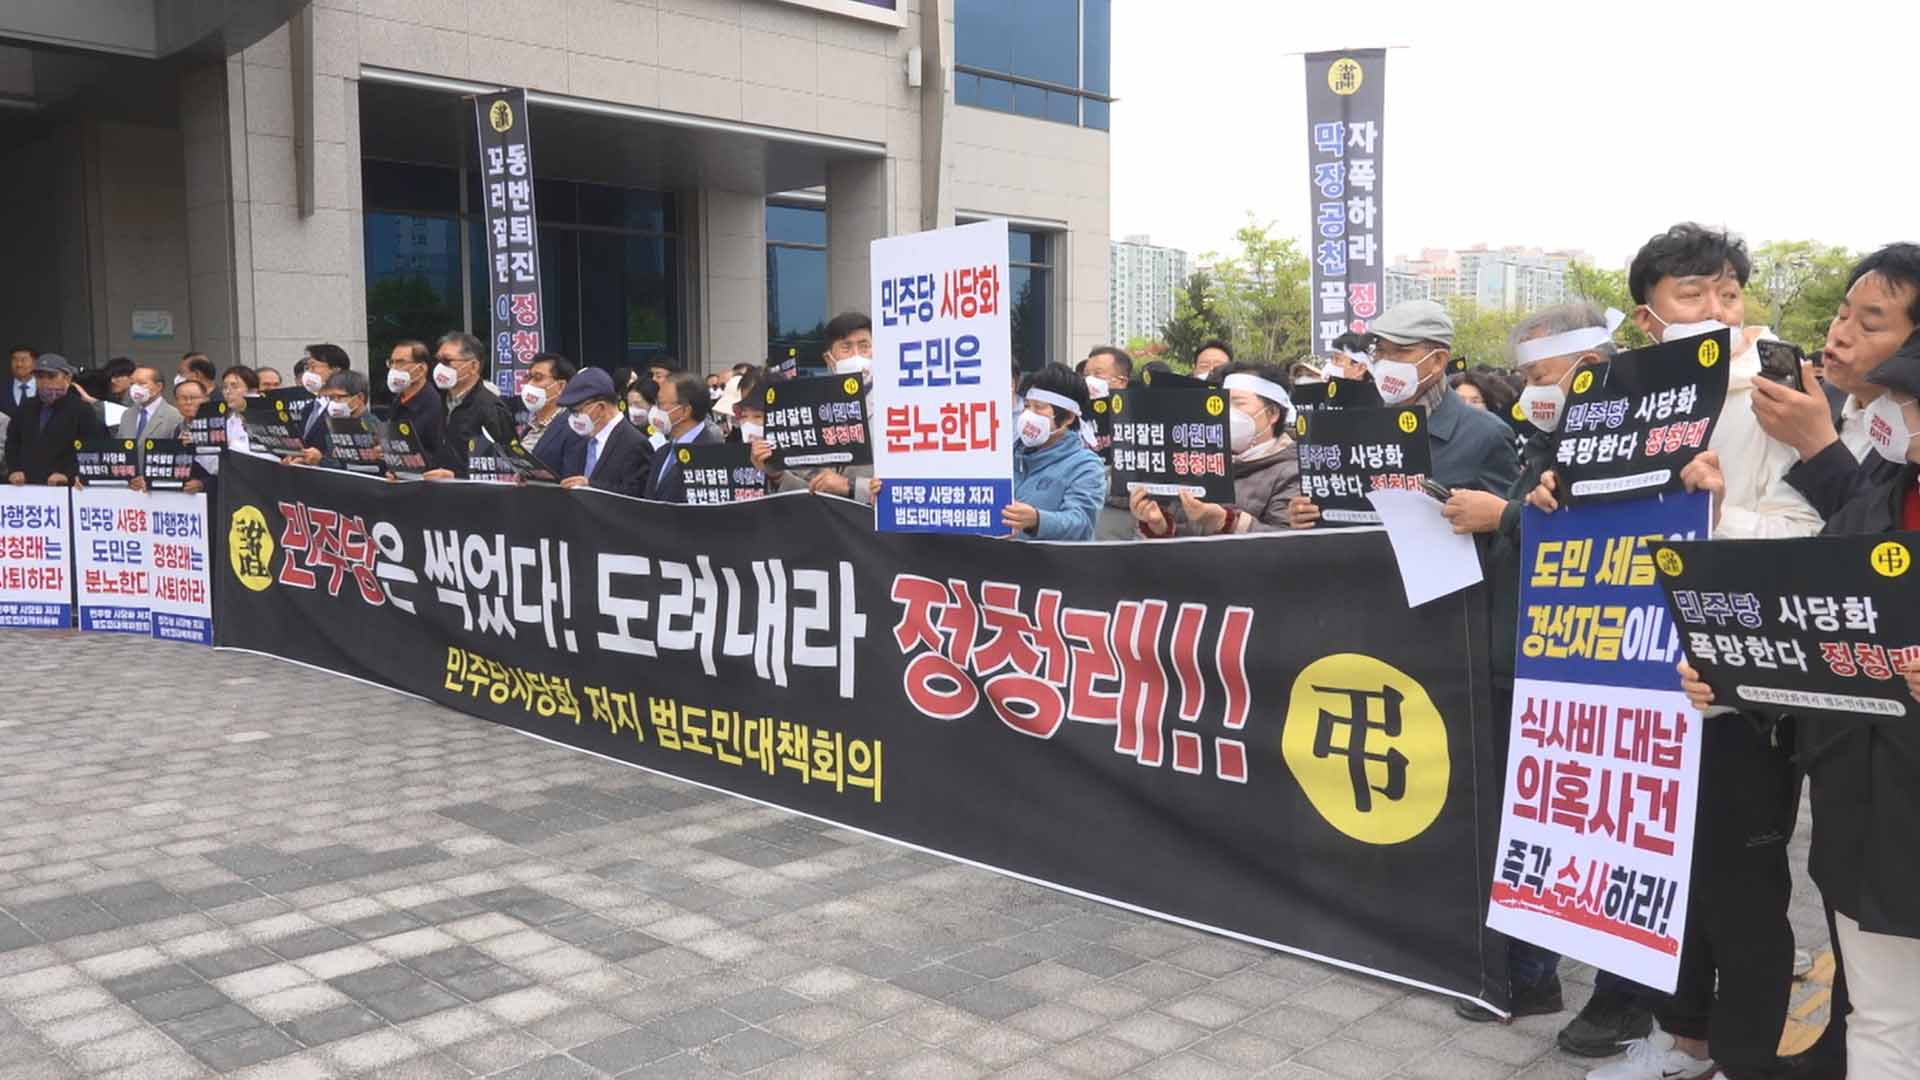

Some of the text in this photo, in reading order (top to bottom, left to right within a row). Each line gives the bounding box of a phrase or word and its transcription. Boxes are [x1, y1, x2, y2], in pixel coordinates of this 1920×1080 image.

[506, 144, 535, 282] 동반퇴진
[1314, 121, 1347, 277] 막장공천
[1348, 120, 1378, 334] 자폭하라 정
[881, 264, 999, 327] 민주당 사당화
[898, 334, 982, 387] 도민은
[766, 406, 813, 427] 꼬리잘린
[886, 400, 999, 453] 분노한다
[1565, 384, 1697, 432] 민주당 사당화
[766, 428, 818, 450] 동반퇴진
[1113, 423, 1165, 446] 꼬리잘린
[1172, 423, 1224, 449] 이원택
[1350, 444, 1404, 469] 사당화
[1556, 417, 1710, 466] 폭망한다 정청래
[683, 468, 728, 485] 꼬리잘린
[1113, 448, 1225, 476] 동반퇴진 정청래
[891, 485, 994, 505] 민주당 사당화 저지
[895, 507, 991, 528] 범도민대책위원회
[80, 507, 113, 531] 민주당
[152, 511, 202, 539] 파행정치
[93, 540, 143, 564] 도민은
[153, 543, 203, 572] 정청래는
[1530, 530, 1697, 588] 도민 세금
[155, 575, 205, 604] 사퇴하라
[1672, 590, 1878, 634] 민주당 사당화
[277, 500, 1254, 784] 민주당은 썩었다! 도려내라 정청래!!
[1688, 631, 1809, 672] 폭망한다
[444, 647, 882, 803] 민주당사당화 저지 범도민대책회의
[1520, 697, 1688, 770] 식사비 대납
[1311, 684, 1409, 813] 弔
[1512, 755, 1680, 857] 의혹사건
[1501, 839, 1678, 935] 즉각 수사하라!
